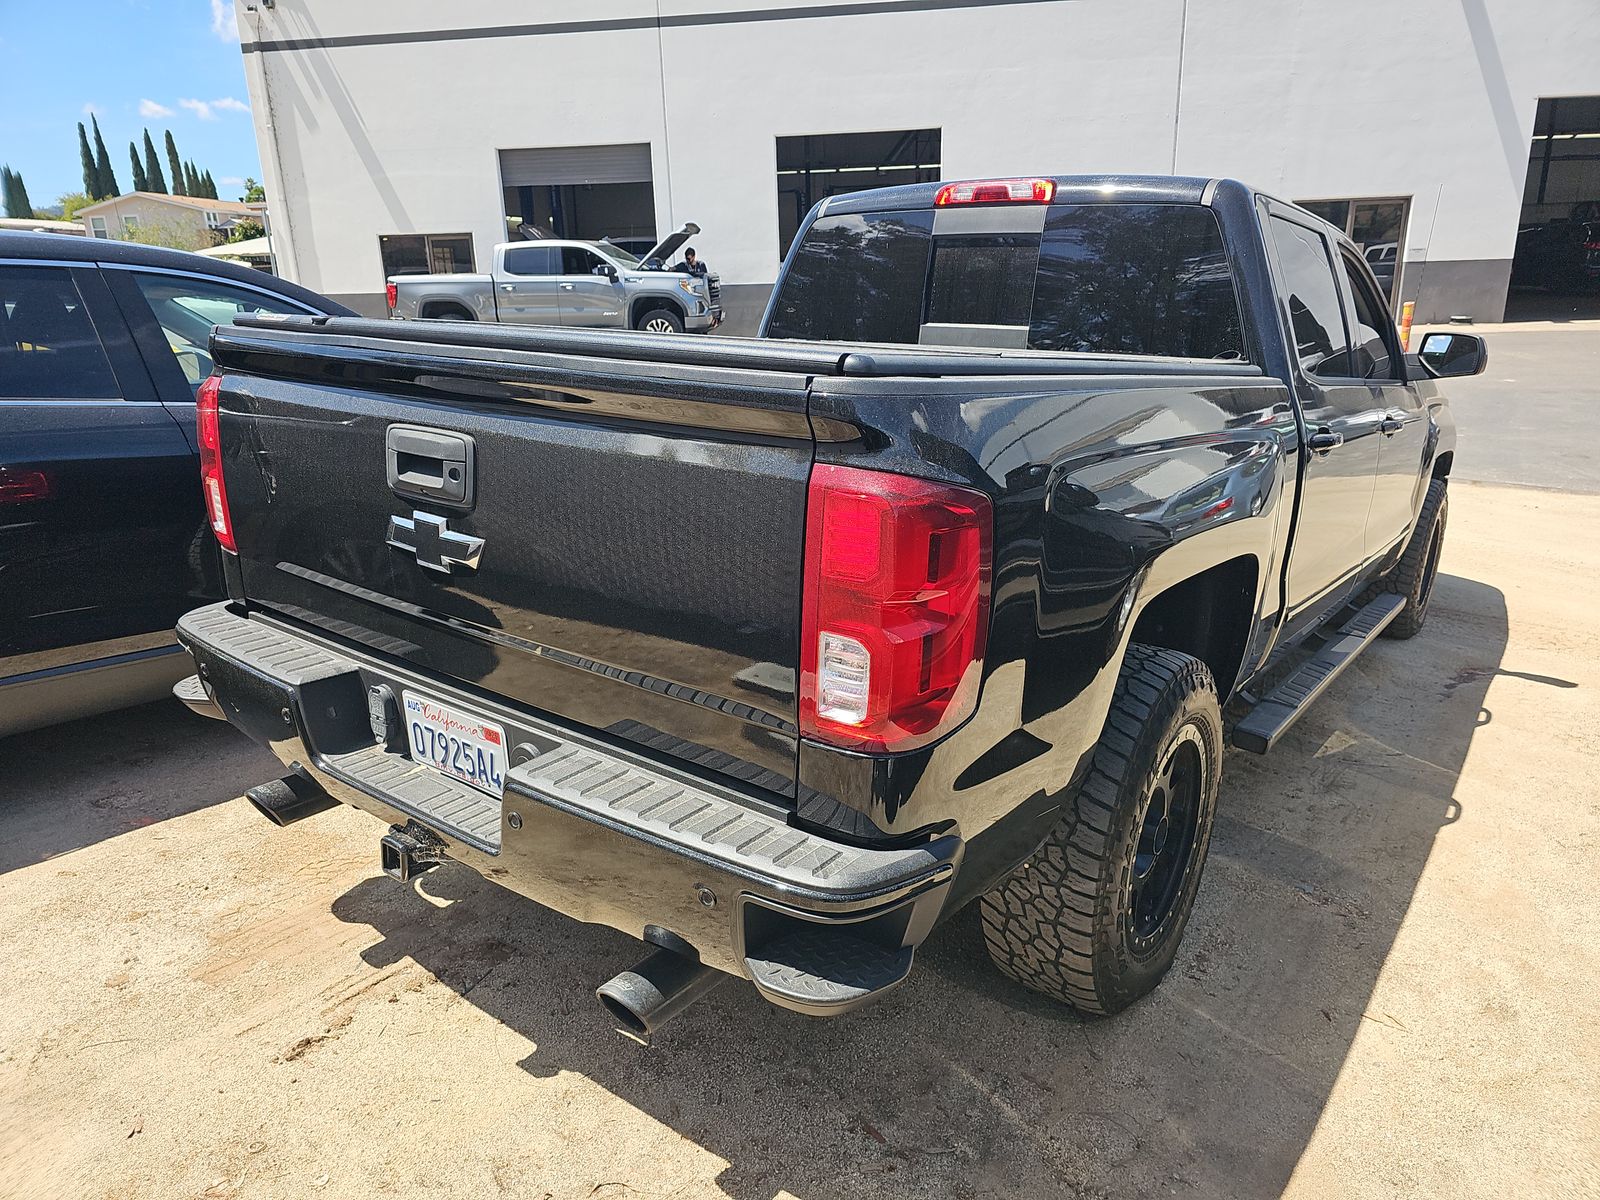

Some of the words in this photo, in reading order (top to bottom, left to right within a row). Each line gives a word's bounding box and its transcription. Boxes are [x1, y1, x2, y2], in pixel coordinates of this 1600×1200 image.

[407, 699, 421, 712] AUG
[423, 703, 478, 735] California
[412, 722, 502, 791] 07925A4
